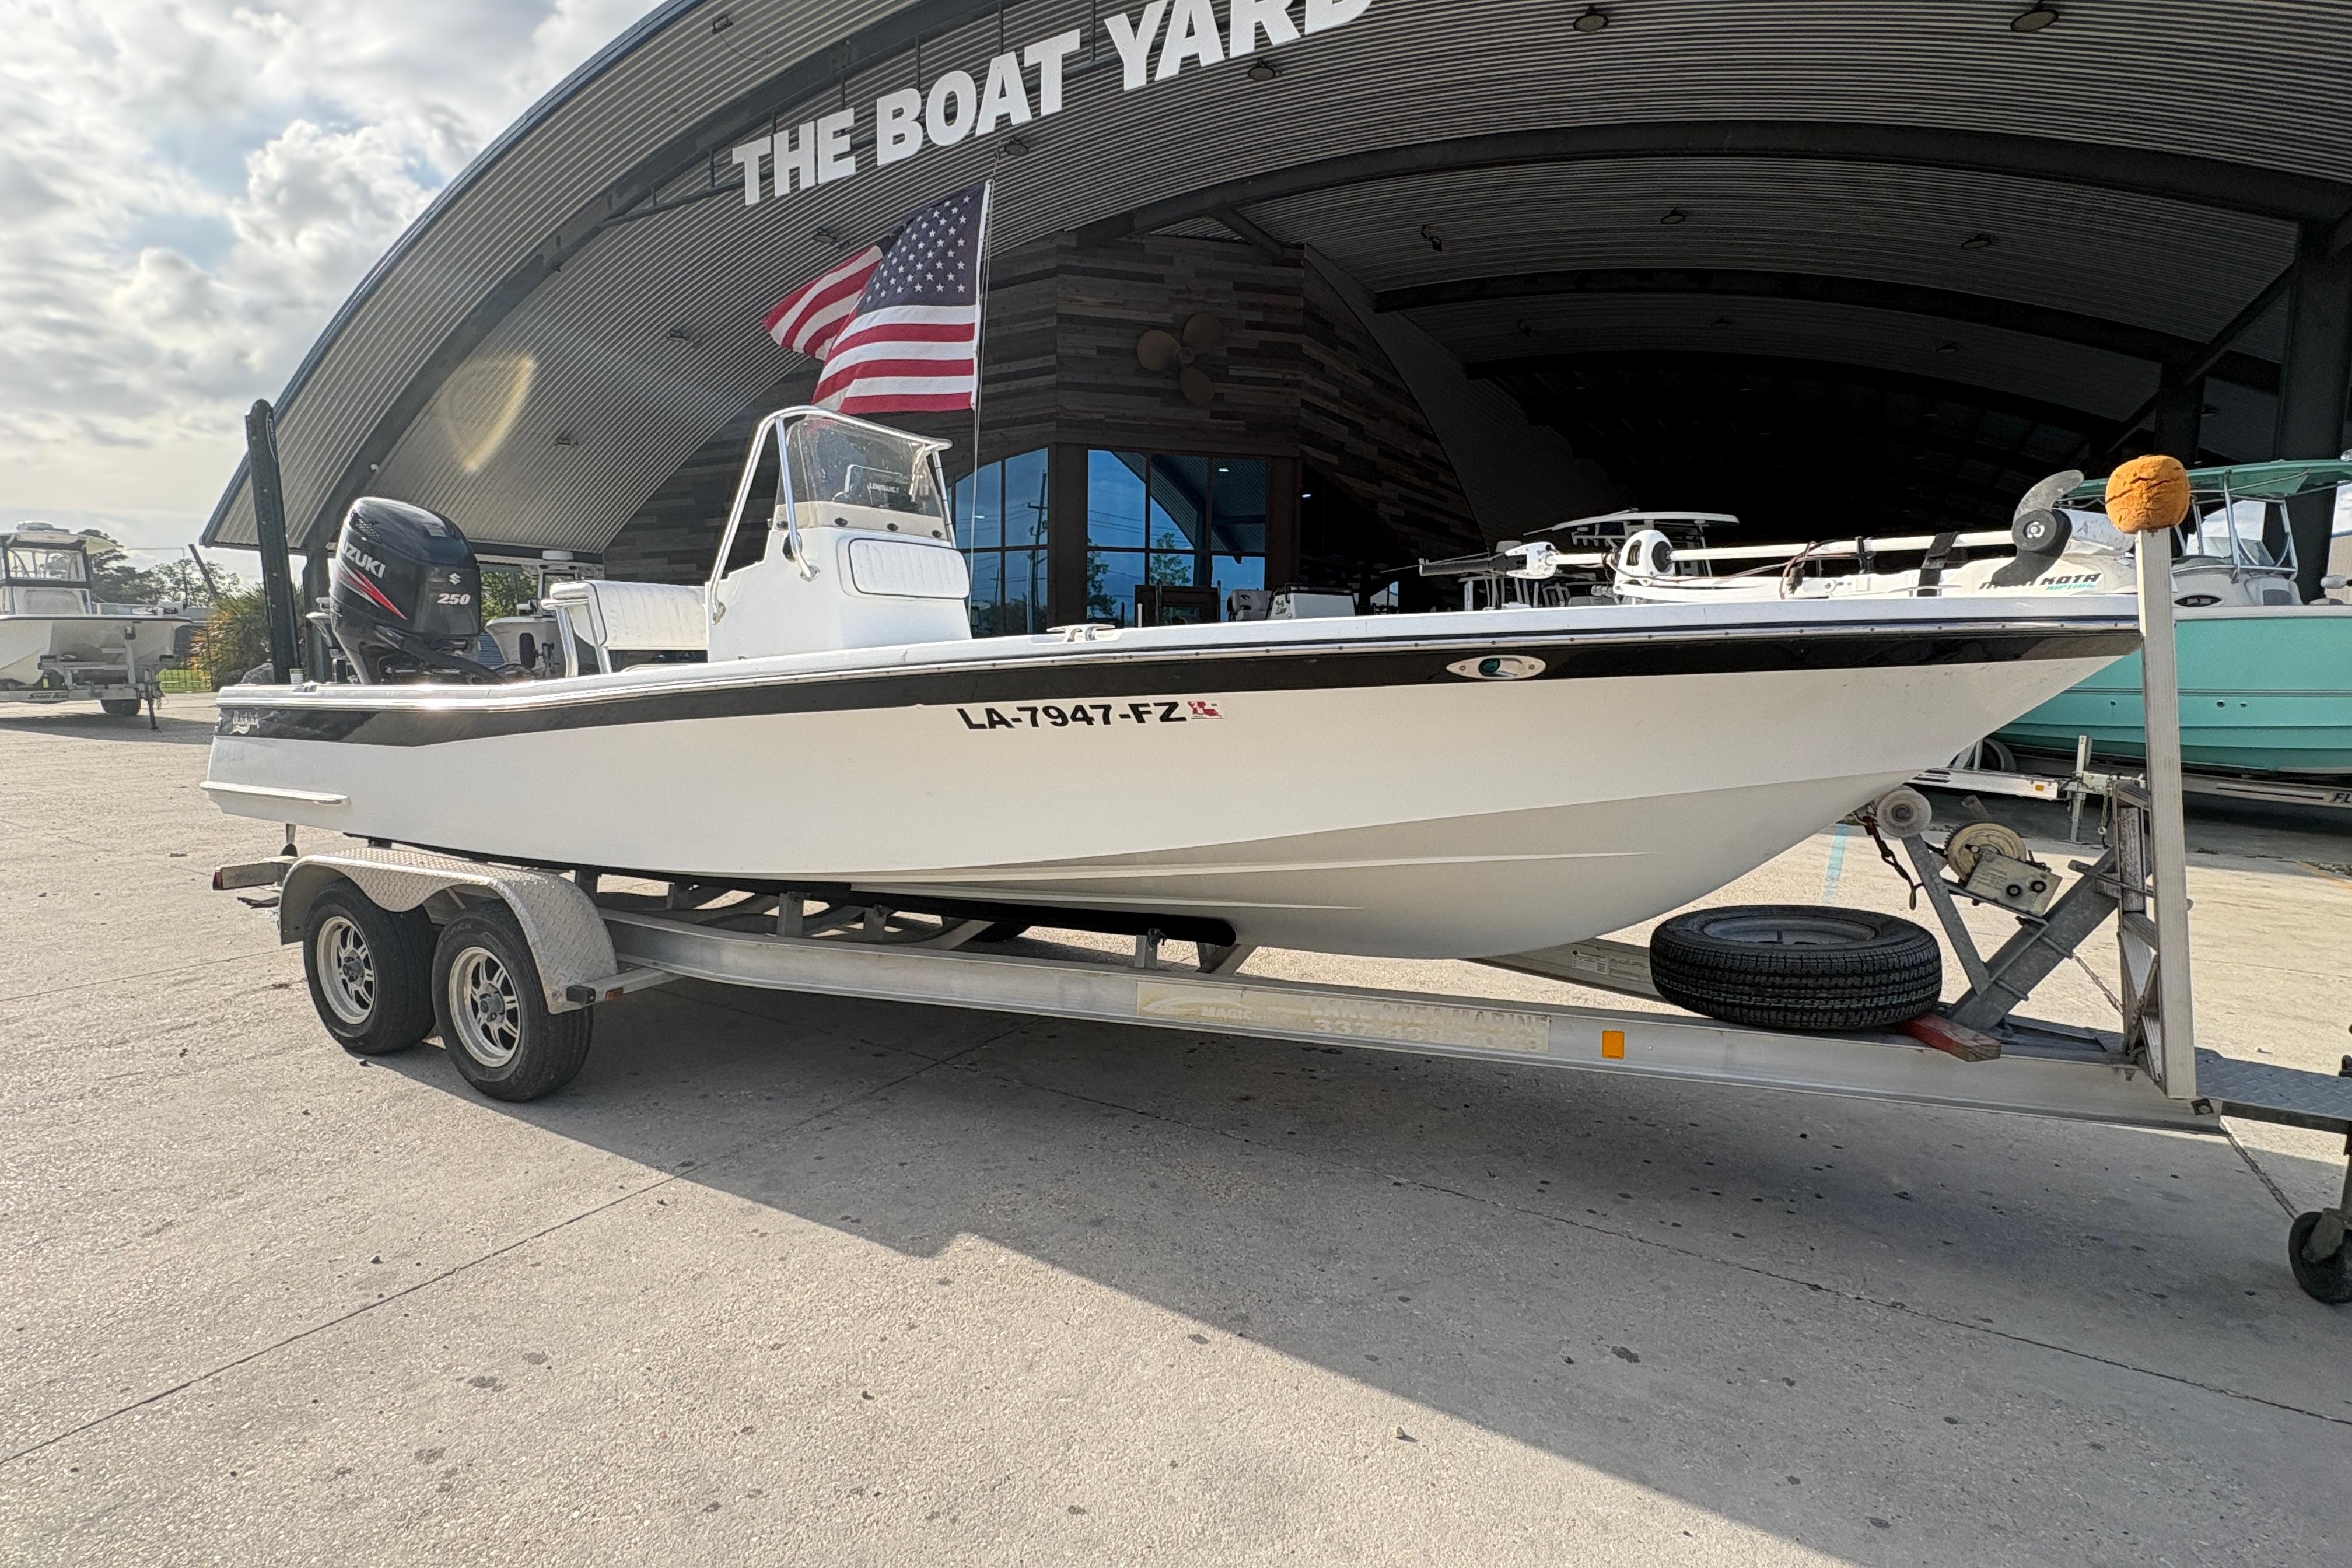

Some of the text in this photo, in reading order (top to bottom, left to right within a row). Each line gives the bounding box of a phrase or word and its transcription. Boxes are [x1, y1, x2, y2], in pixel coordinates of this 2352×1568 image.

[732, 107, 858, 206] THE
[876, 29, 1081, 167] BOAT
[340, 540, 387, 579] UZUKI
[2039, 573, 2102, 586] KOTA
[437, 593, 471, 606] 250
[956, 701, 1187, 730] LA-7947-FZ
[1200, 1006, 1253, 1021] MAGIC
